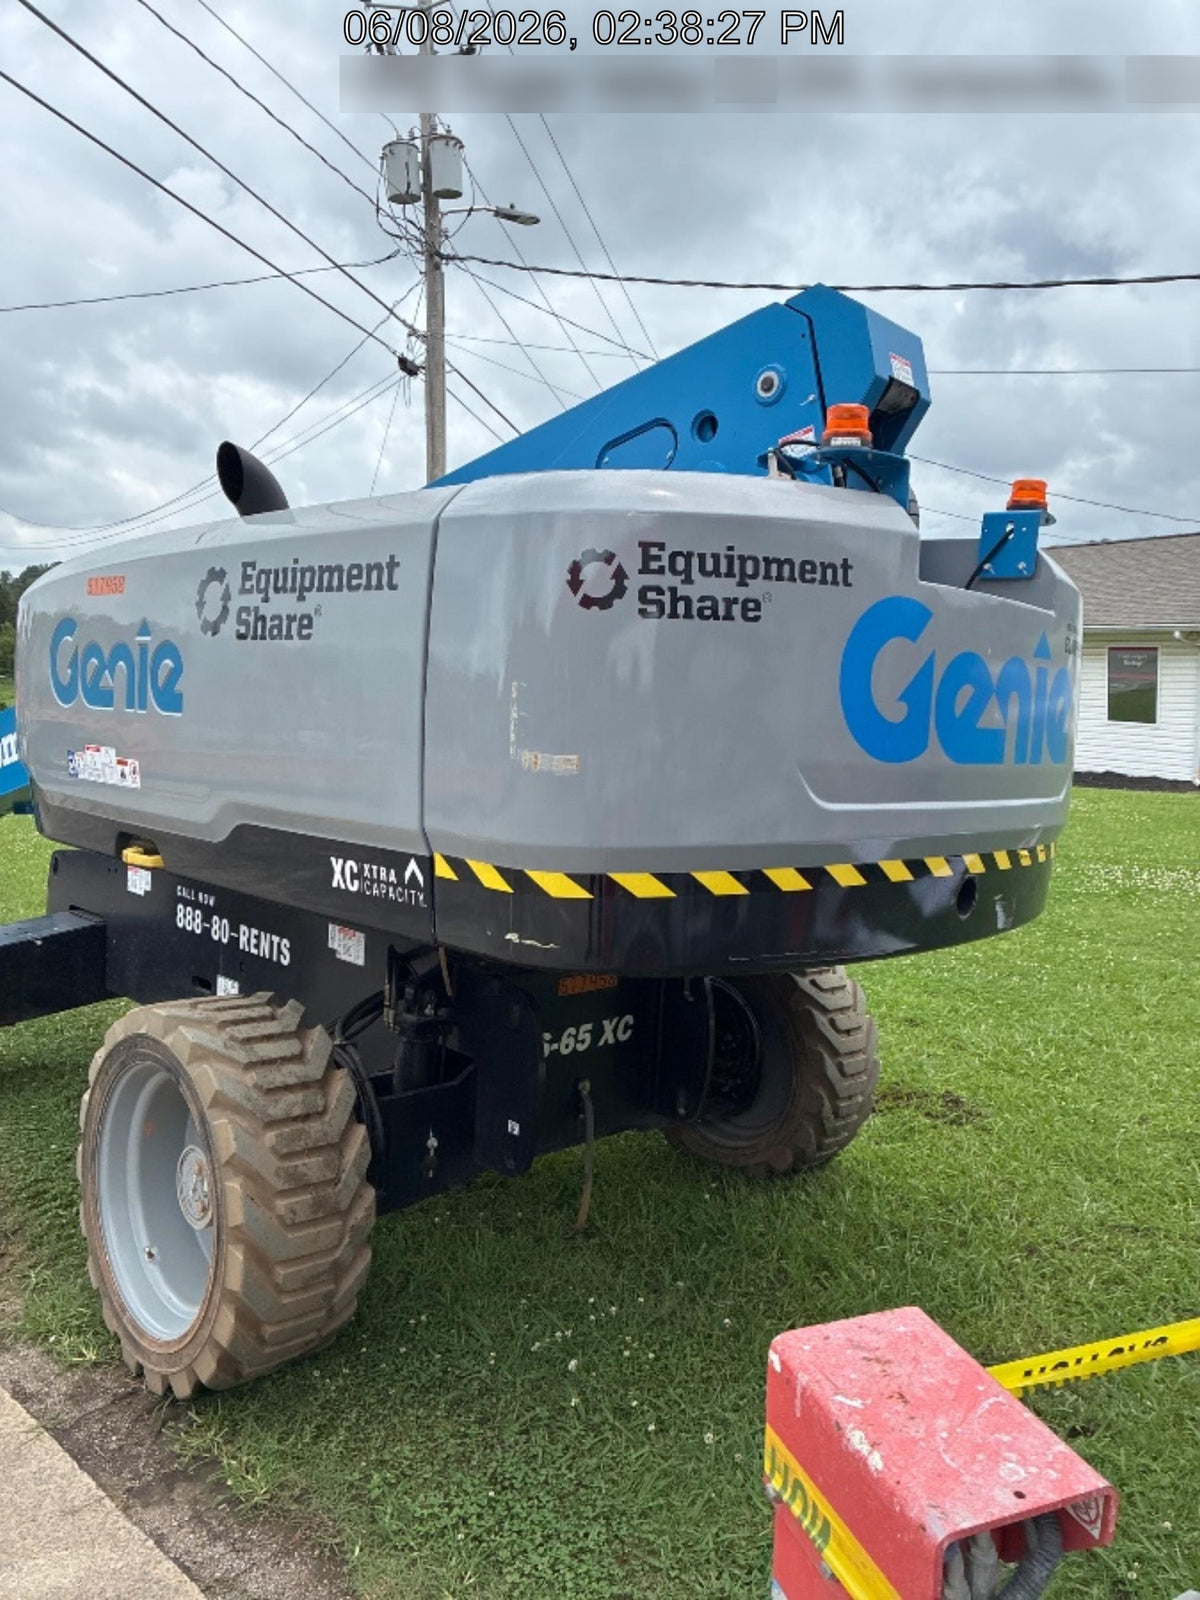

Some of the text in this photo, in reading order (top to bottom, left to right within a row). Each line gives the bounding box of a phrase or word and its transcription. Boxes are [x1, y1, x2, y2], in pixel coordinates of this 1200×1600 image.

[238, 554, 400, 603] Equipment
[638, 540, 853, 588] Equipment
[49, 616, 184, 717] Genie
[839, 595, 1072, 765] Genie
[177, 885, 196, 901] CALL
[330, 856, 360, 893] XC
[363, 863, 398, 884] XTRA
[363, 881, 426, 907] CAPACITY
[176, 902, 291, 967] 888-80-RENTS
[598, 1014, 634, 1047] XC
